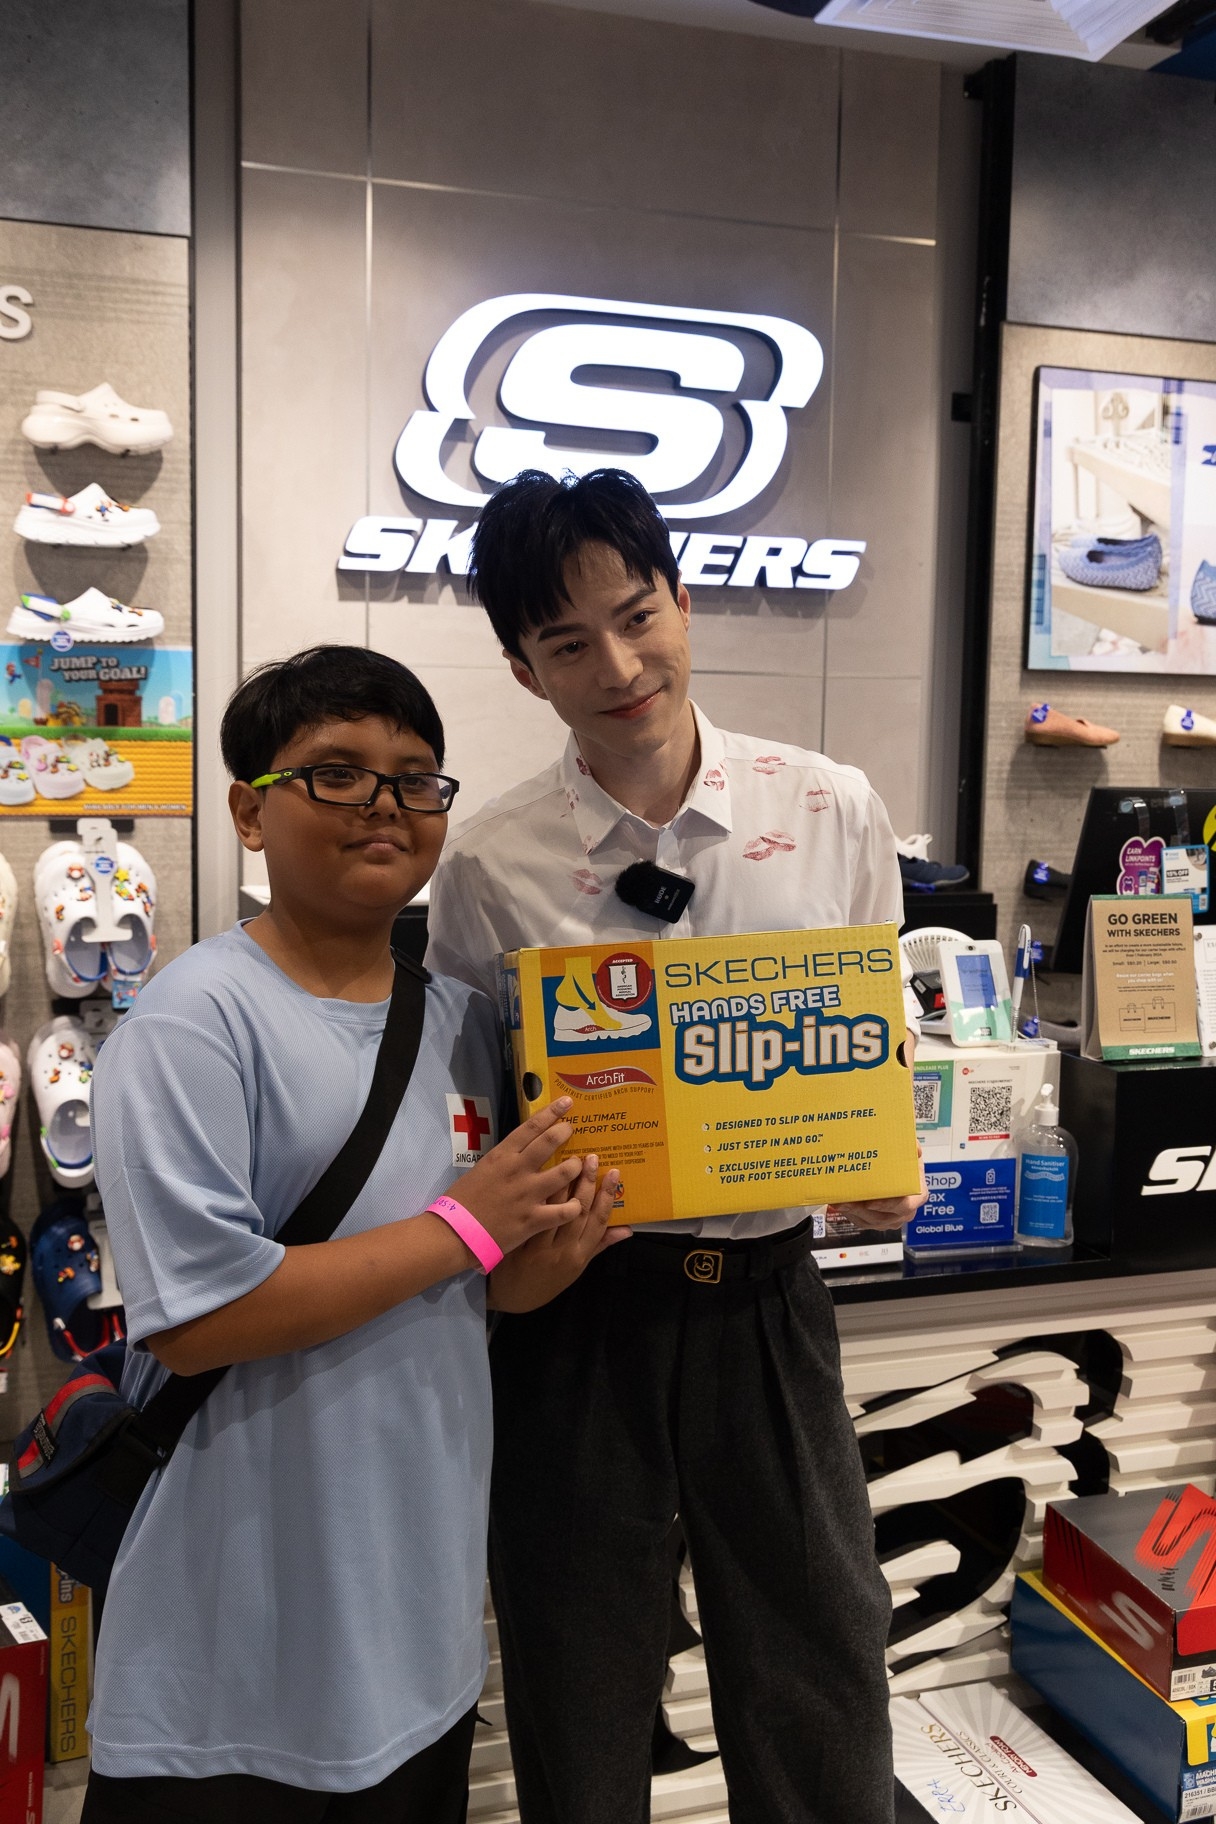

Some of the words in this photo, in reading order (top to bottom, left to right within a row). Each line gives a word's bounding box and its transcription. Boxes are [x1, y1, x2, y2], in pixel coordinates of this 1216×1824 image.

[50, 656, 97, 670] JUMP
[101, 657, 117, 667] TO
[63, 670, 98, 681] YOUR
[99, 666, 146, 681] GOAL!
[1107, 914, 1128, 925] GO
[1132, 913, 1178, 924] GREEN
[1107, 929, 1131, 937] WITH
[1133, 928, 1180, 937] SKECHERS
[664, 948, 893, 988] SKECHERS
[671, 994, 765, 1024] HANDS
[772, 985, 840, 1013] FREE
[683, 1015, 883, 1083] Slip-ins
[1129, 1046, 1175, 1055] SKECHERS
[554, 1078, 583, 1099] PODIATRIST
[584, 1092, 612, 1101] CERTIFIED
[613, 1086, 628, 1095] ARCH
[629, 1086, 655, 1095] SUPPORT
[561, 1115, 579, 1124] THE
[581, 1112, 627, 1123] ULTIMATE
[715, 1118, 762, 1131] DESIGNED
[765, 1118, 777, 1126] TO
[779, 1115, 799, 1125] SLIP
[802, 1114, 815, 1123] ON
[817, 1111, 848, 1121] HANDS
[851, 1108, 876, 1118] FREE.
[572, 1125, 608, 1135] MFORT
[610, 1121, 659, 1132] SOLUTION
[717, 1142, 741, 1151] JUST
[744, 1139, 768, 1149] STEP
[770, 1138, 780, 1146] IN
[783, 1136, 802, 1146] AND
[719, 1160, 771, 1173] EXCLUSIVE
[774, 1157, 797, 1167] HEEL
[848, 1150, 878, 1160] HOLDS
[720, 1172, 745, 1184] YOUR
[748, 1171, 771, 1181] FOOT
[774, 1167, 823, 1179] SECURELY
[825, 1166, 835, 1174] IN
[838, 1162, 871, 1173] PLACE!
[1141, 1146, 1216, 1196] S
[928, 1191, 945, 1202] ax
[924, 1204, 954, 1216] Free
[916, 1225, 943, 1234] Global
[945, 1224, 963, 1232] Blue
[60, 1616, 77, 1753] SKECHERS
[955, 1731, 992, 1763] CLASSICS
[920, 1723, 1017, 1811] SKECHERS
[1185, 1790, 1203, 1798] 216351
